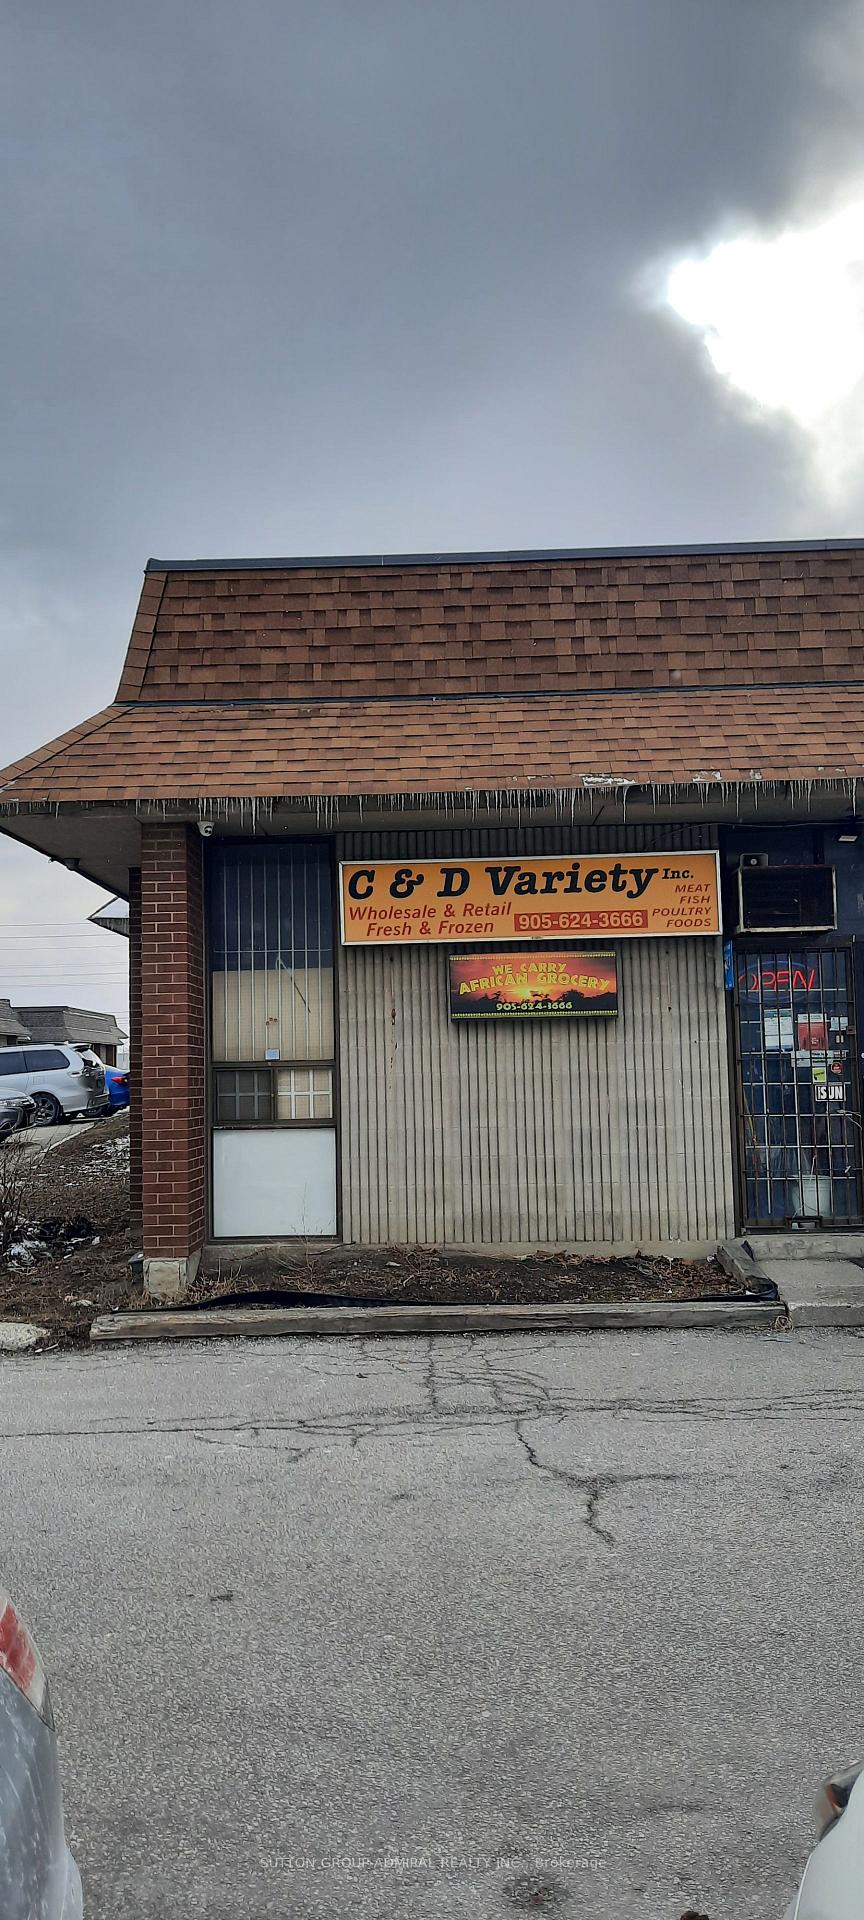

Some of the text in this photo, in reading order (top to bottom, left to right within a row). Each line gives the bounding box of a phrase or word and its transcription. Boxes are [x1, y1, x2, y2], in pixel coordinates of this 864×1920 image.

[348, 863, 695, 900] C & D Variety Inc.
[674, 883, 711, 894] MEAT
[679, 895, 711, 905] FISH
[349, 902, 512, 921] Wholesale & Retail
[651, 906, 712, 917] POULTRY
[518, 911, 644, 930] 905-624-3666
[666, 918, 712, 928] FOODS
[366, 920, 495, 937] Fresh & Frozen
[493, 962, 567, 975] WE CARRY
[459, 973, 611, 995] AFRICAN GROCERY
